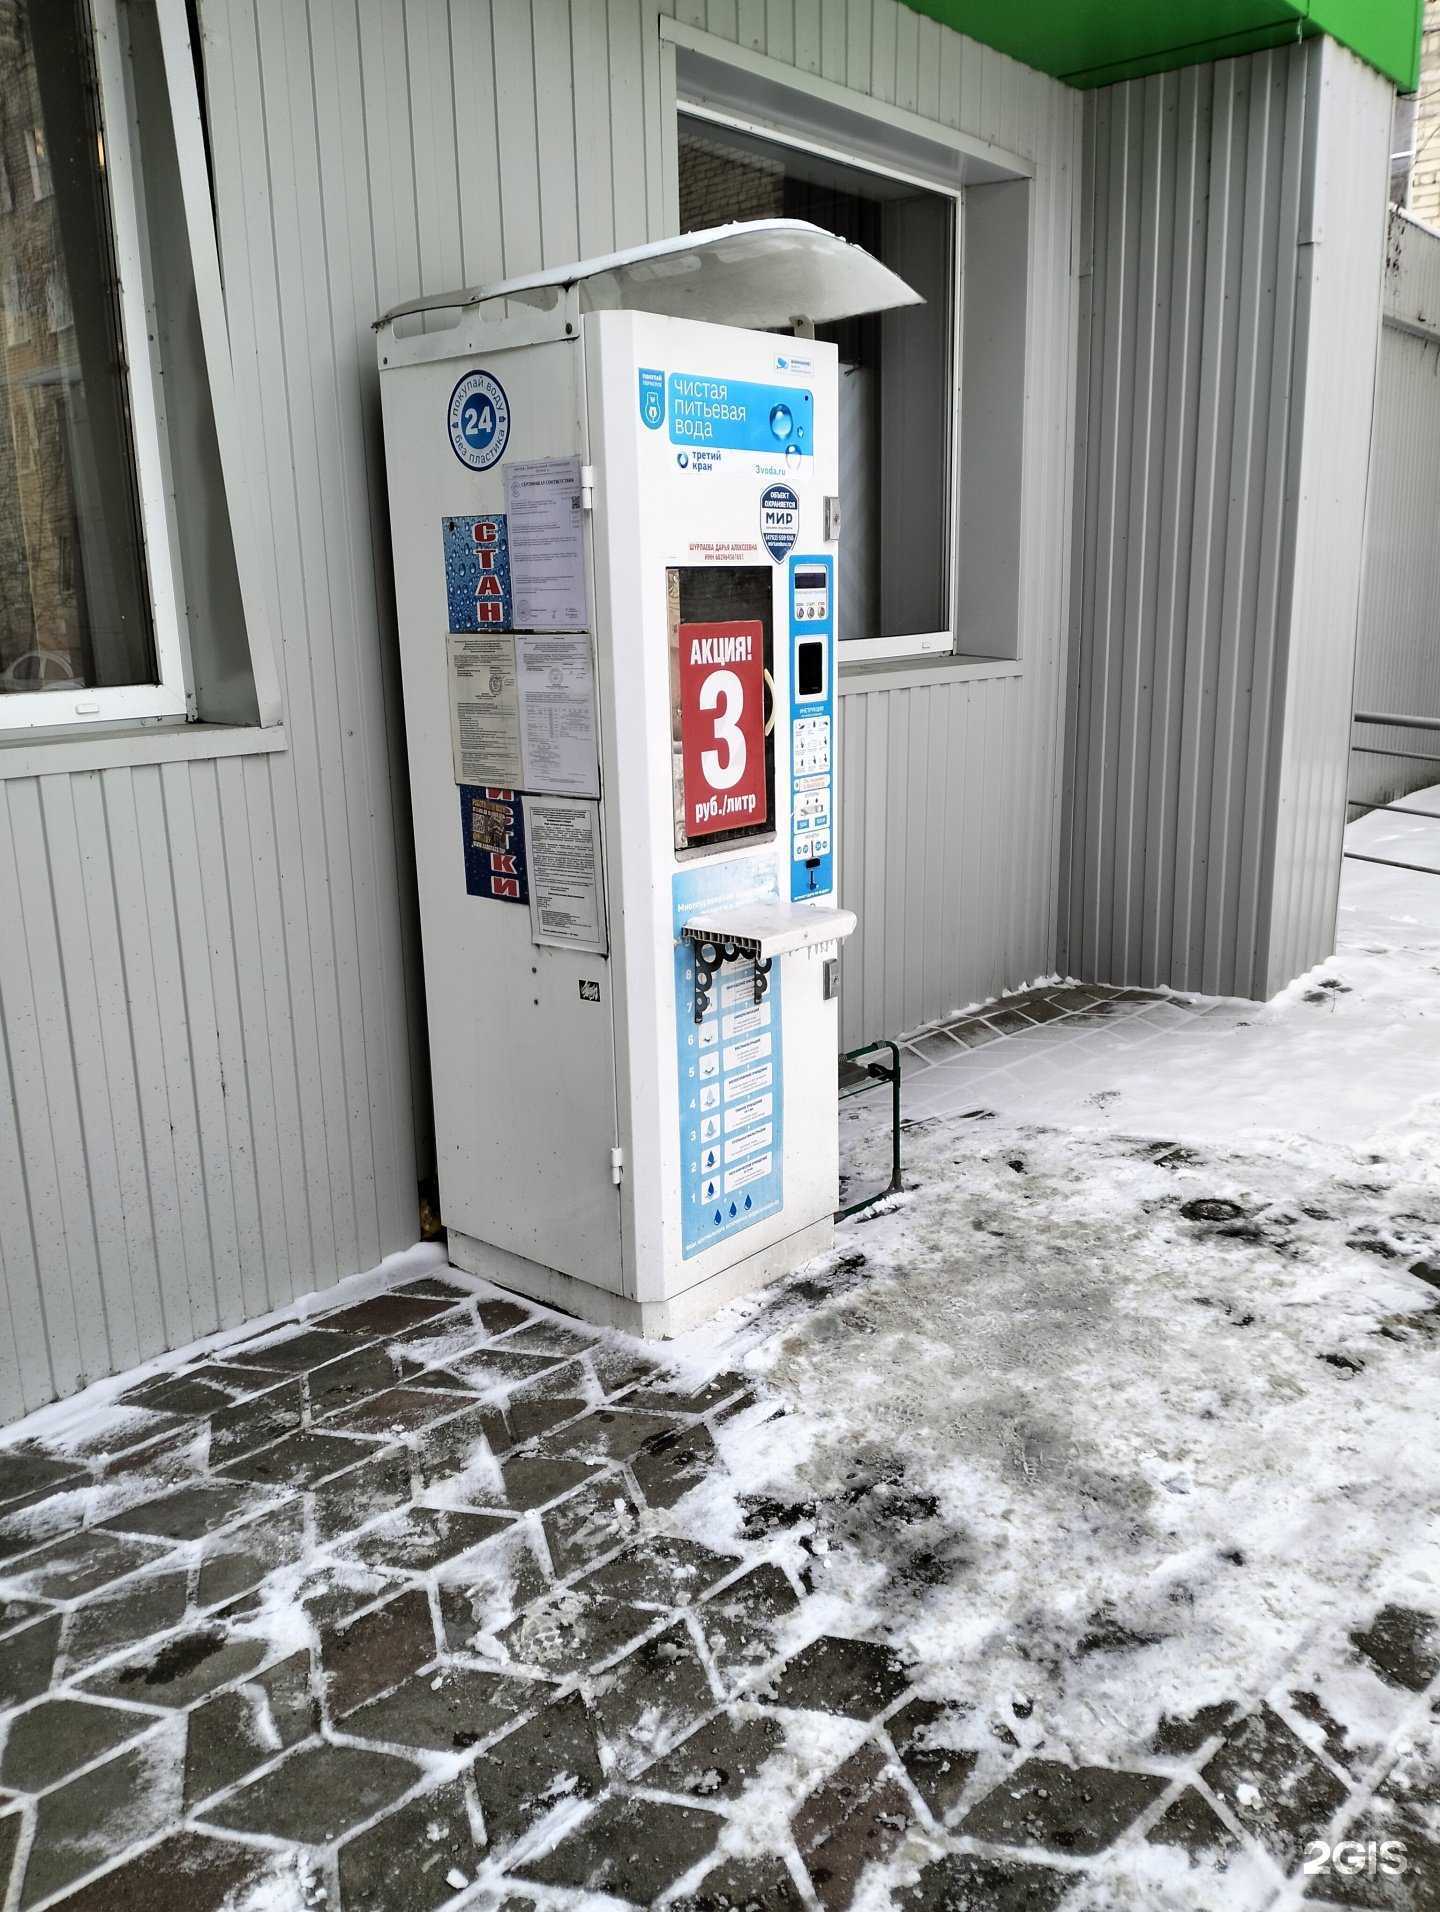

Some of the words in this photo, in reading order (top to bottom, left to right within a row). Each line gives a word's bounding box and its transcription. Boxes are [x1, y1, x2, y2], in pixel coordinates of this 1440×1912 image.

[453, 376, 484, 416] покупай
[486, 381, 505, 411] воду
[674, 380, 728, 400] чистая
[674, 400, 746, 422] питьевая
[464, 405, 493, 436] 24
[675, 419, 713, 440] вода
[454, 434, 468, 456] без
[468, 429, 505, 465] пластика
[692, 450, 722, 462] третий
[692, 461, 713, 472] кран
[755, 464, 786, 477] 3voda.ru
[770, 491, 790, 499] ОБЪЕКТ
[764, 500, 796, 509] ОХРАНЯЕТСЯ
[765, 511, 793, 525] МИР
[690, 636, 753, 667] АКЦИЯ!
[699, 669, 748, 790] 3
[695, 792, 757, 824] руб./литр
[685, 968, 693, 981] 8
[686, 1002, 694, 1014] 7
[687, 1034, 694, 1047] 6
[689, 1099, 697, 1111] 4
[690, 1130, 697, 1142] 3
[690, 1162, 697, 1174] 2
[691, 1192, 697, 1203] 1
